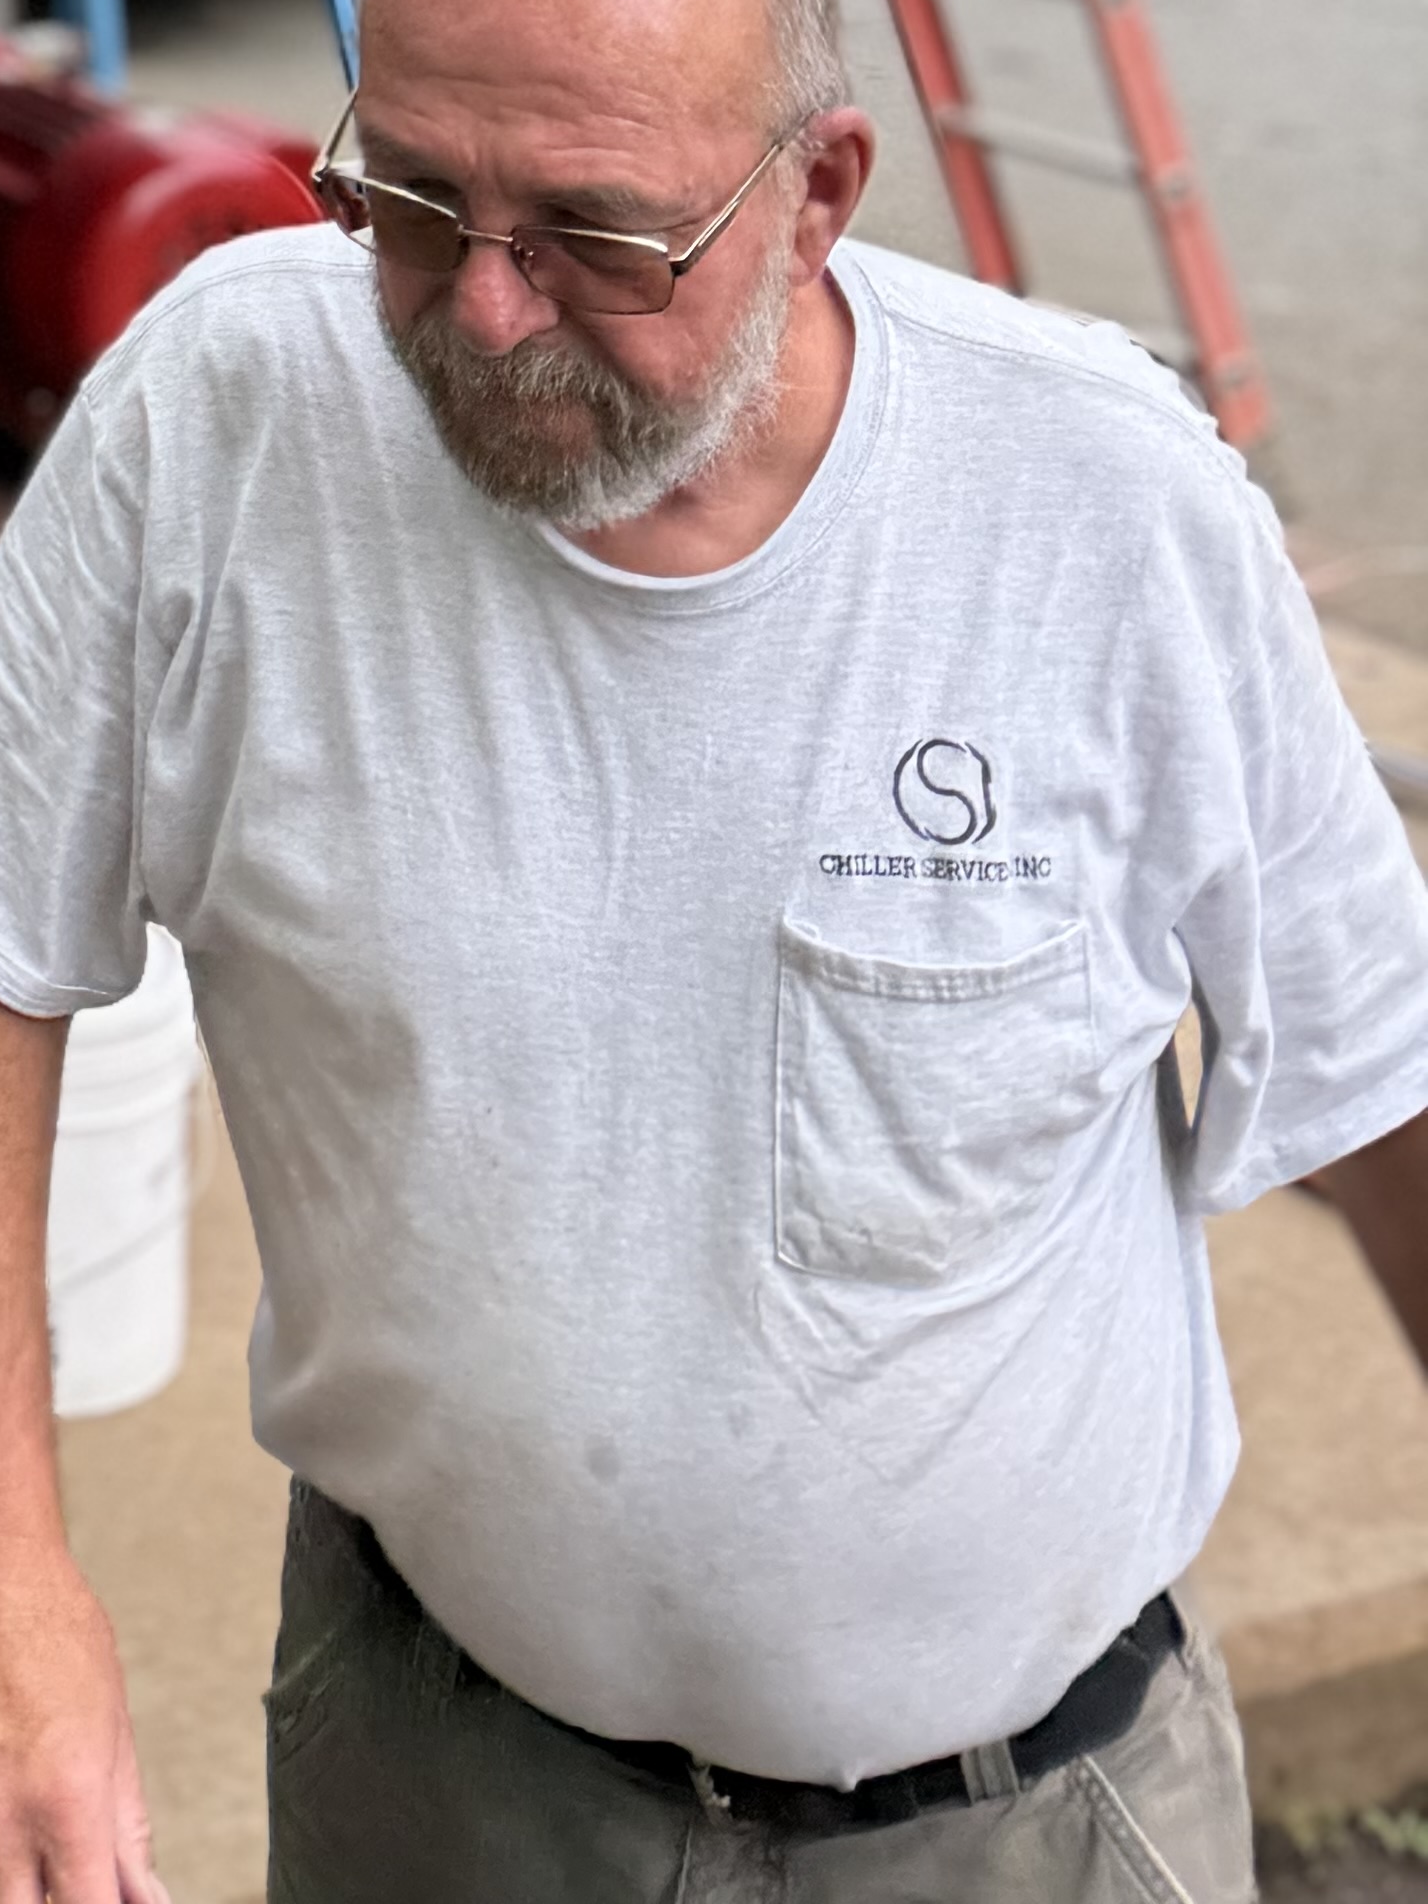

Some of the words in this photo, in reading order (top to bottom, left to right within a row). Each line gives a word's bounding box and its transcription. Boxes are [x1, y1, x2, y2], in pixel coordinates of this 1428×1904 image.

[819, 854, 918, 878] CHILLER
[921, 856, 1010, 882] SERVICE
[1015, 855, 1052, 880] INC
